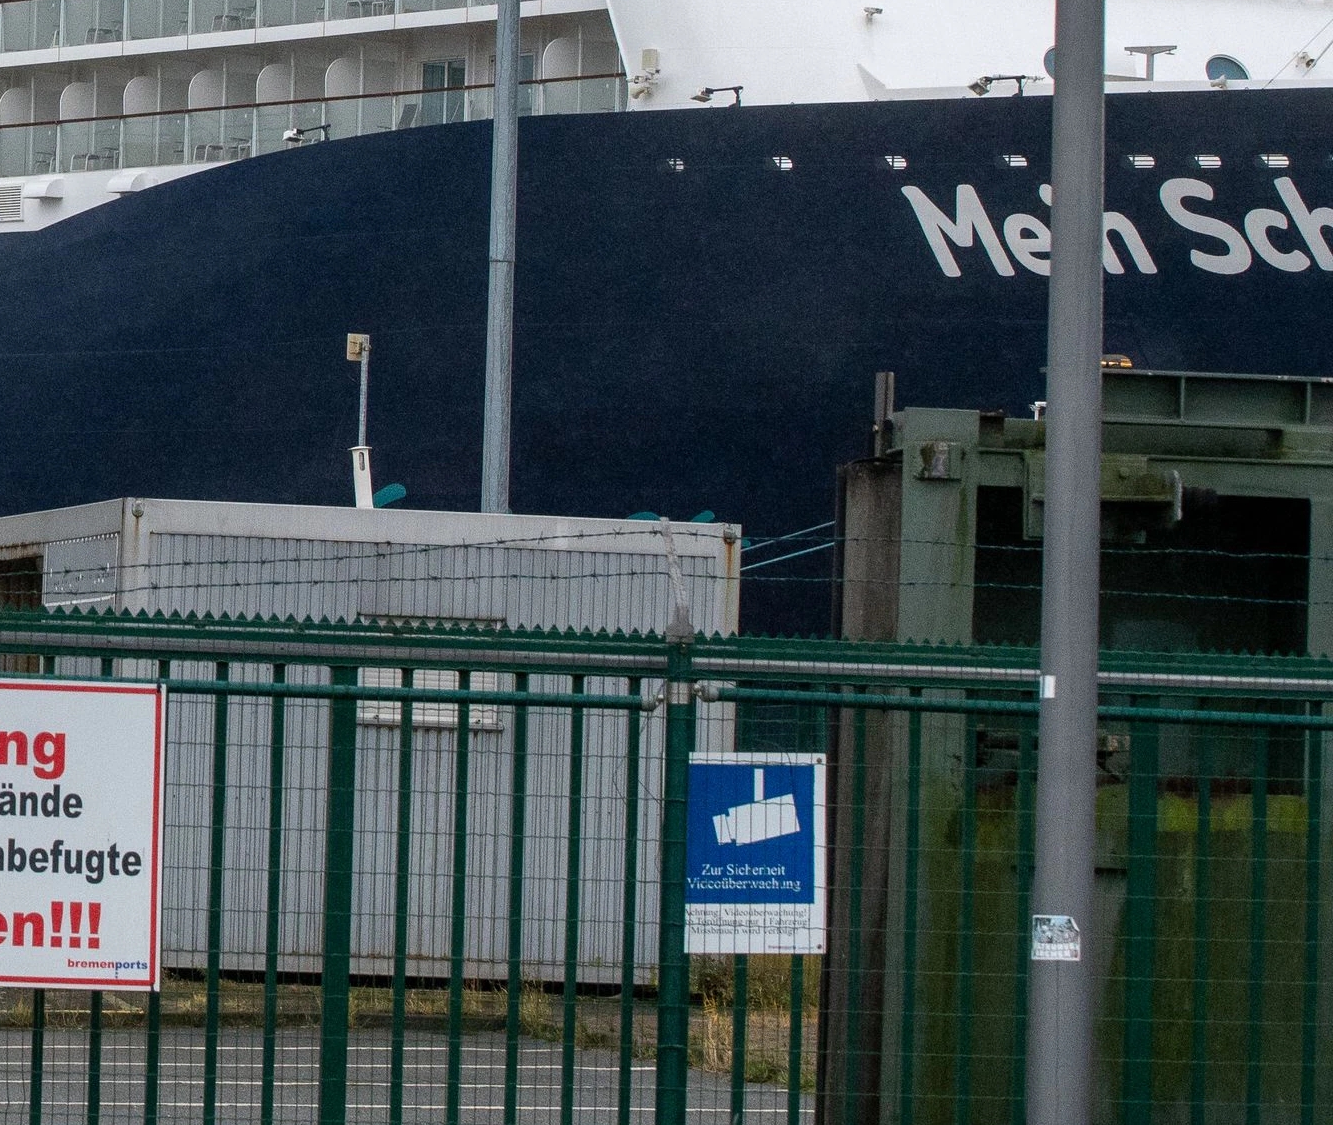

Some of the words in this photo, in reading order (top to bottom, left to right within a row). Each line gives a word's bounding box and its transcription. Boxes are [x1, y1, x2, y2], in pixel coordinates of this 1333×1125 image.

[901, 184, 1157, 278] Men
[701, 863, 724, 875] Zur
[67, 959, 148, 971] bremenports
